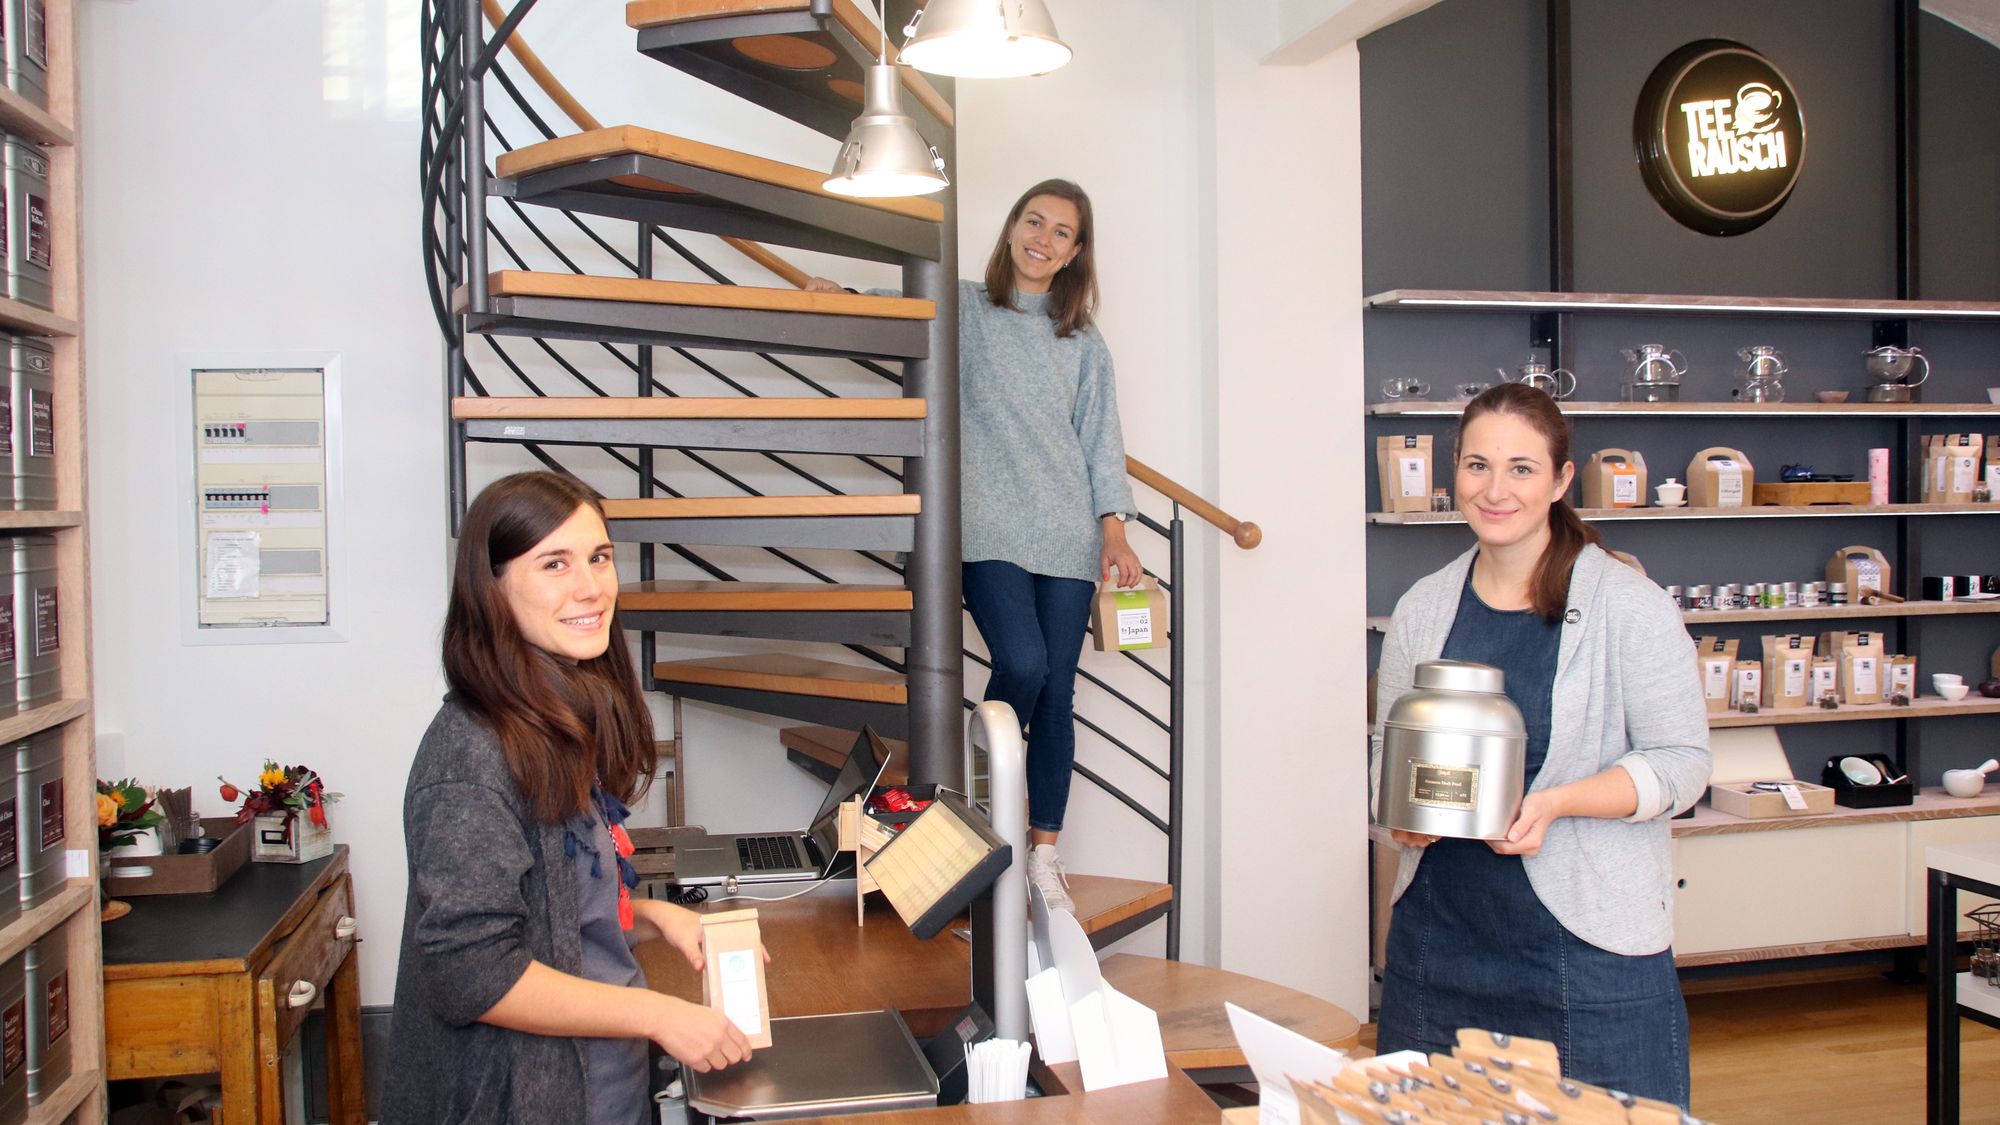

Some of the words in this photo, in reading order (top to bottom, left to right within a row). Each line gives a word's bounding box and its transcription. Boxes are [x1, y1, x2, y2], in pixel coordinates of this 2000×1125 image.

[1681, 99, 1734, 140] TEE
[1688, 132, 1787, 177] RAUSCH
[1128, 626, 1149, 635] Japan
